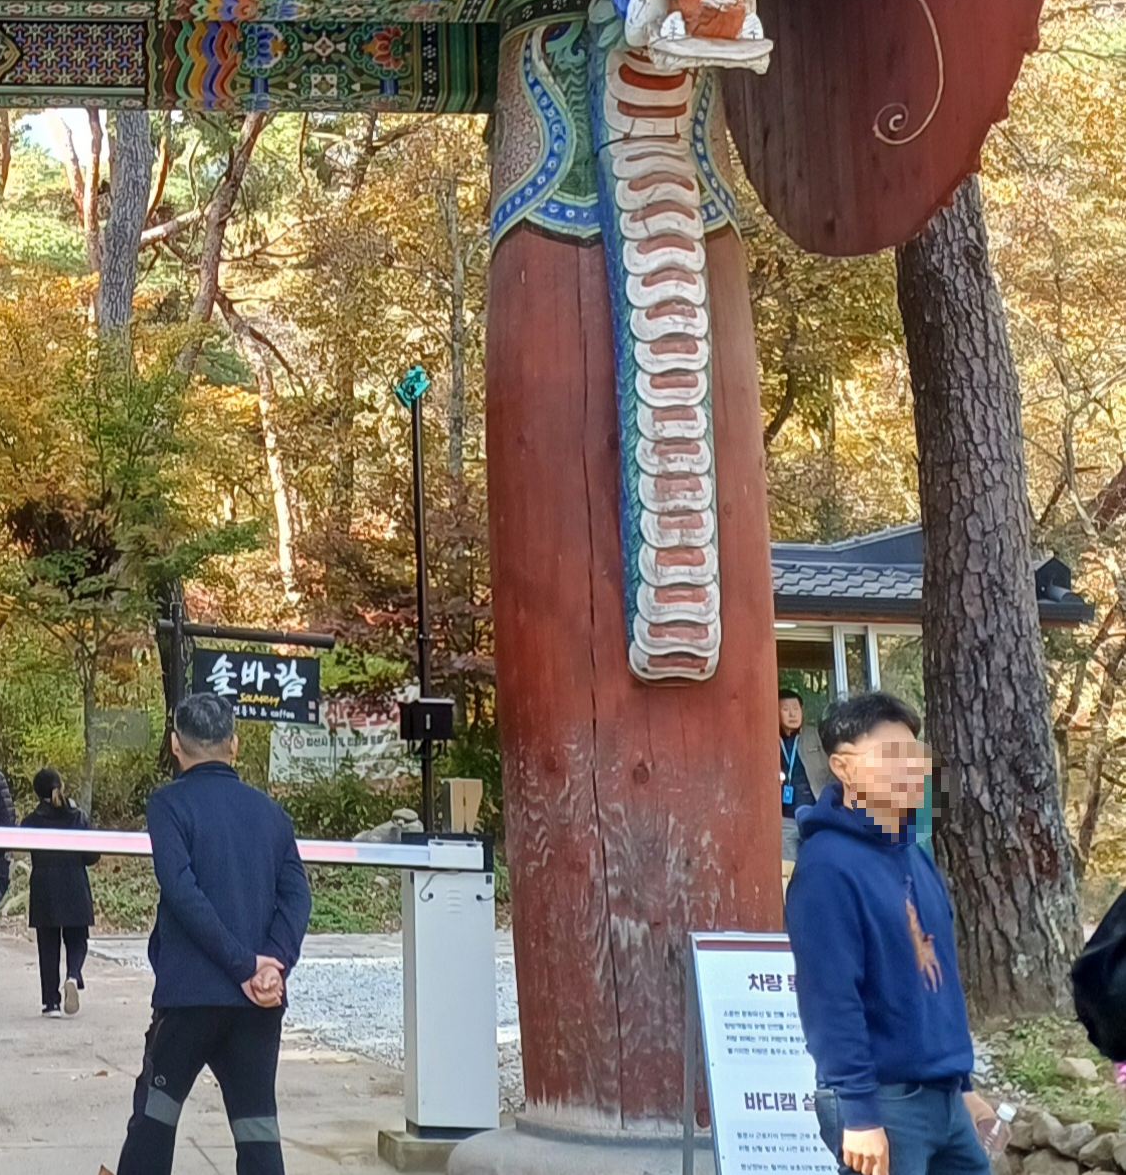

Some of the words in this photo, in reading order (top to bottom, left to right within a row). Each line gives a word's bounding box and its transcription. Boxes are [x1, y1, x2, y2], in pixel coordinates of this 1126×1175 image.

[206, 654, 307, 701] 솔바람
[260, 707, 267, 717] &
[270, 708, 295, 720] coffee
[748, 973, 783, 992] 차량
[744, 1092, 797, 1112] 바디캠
